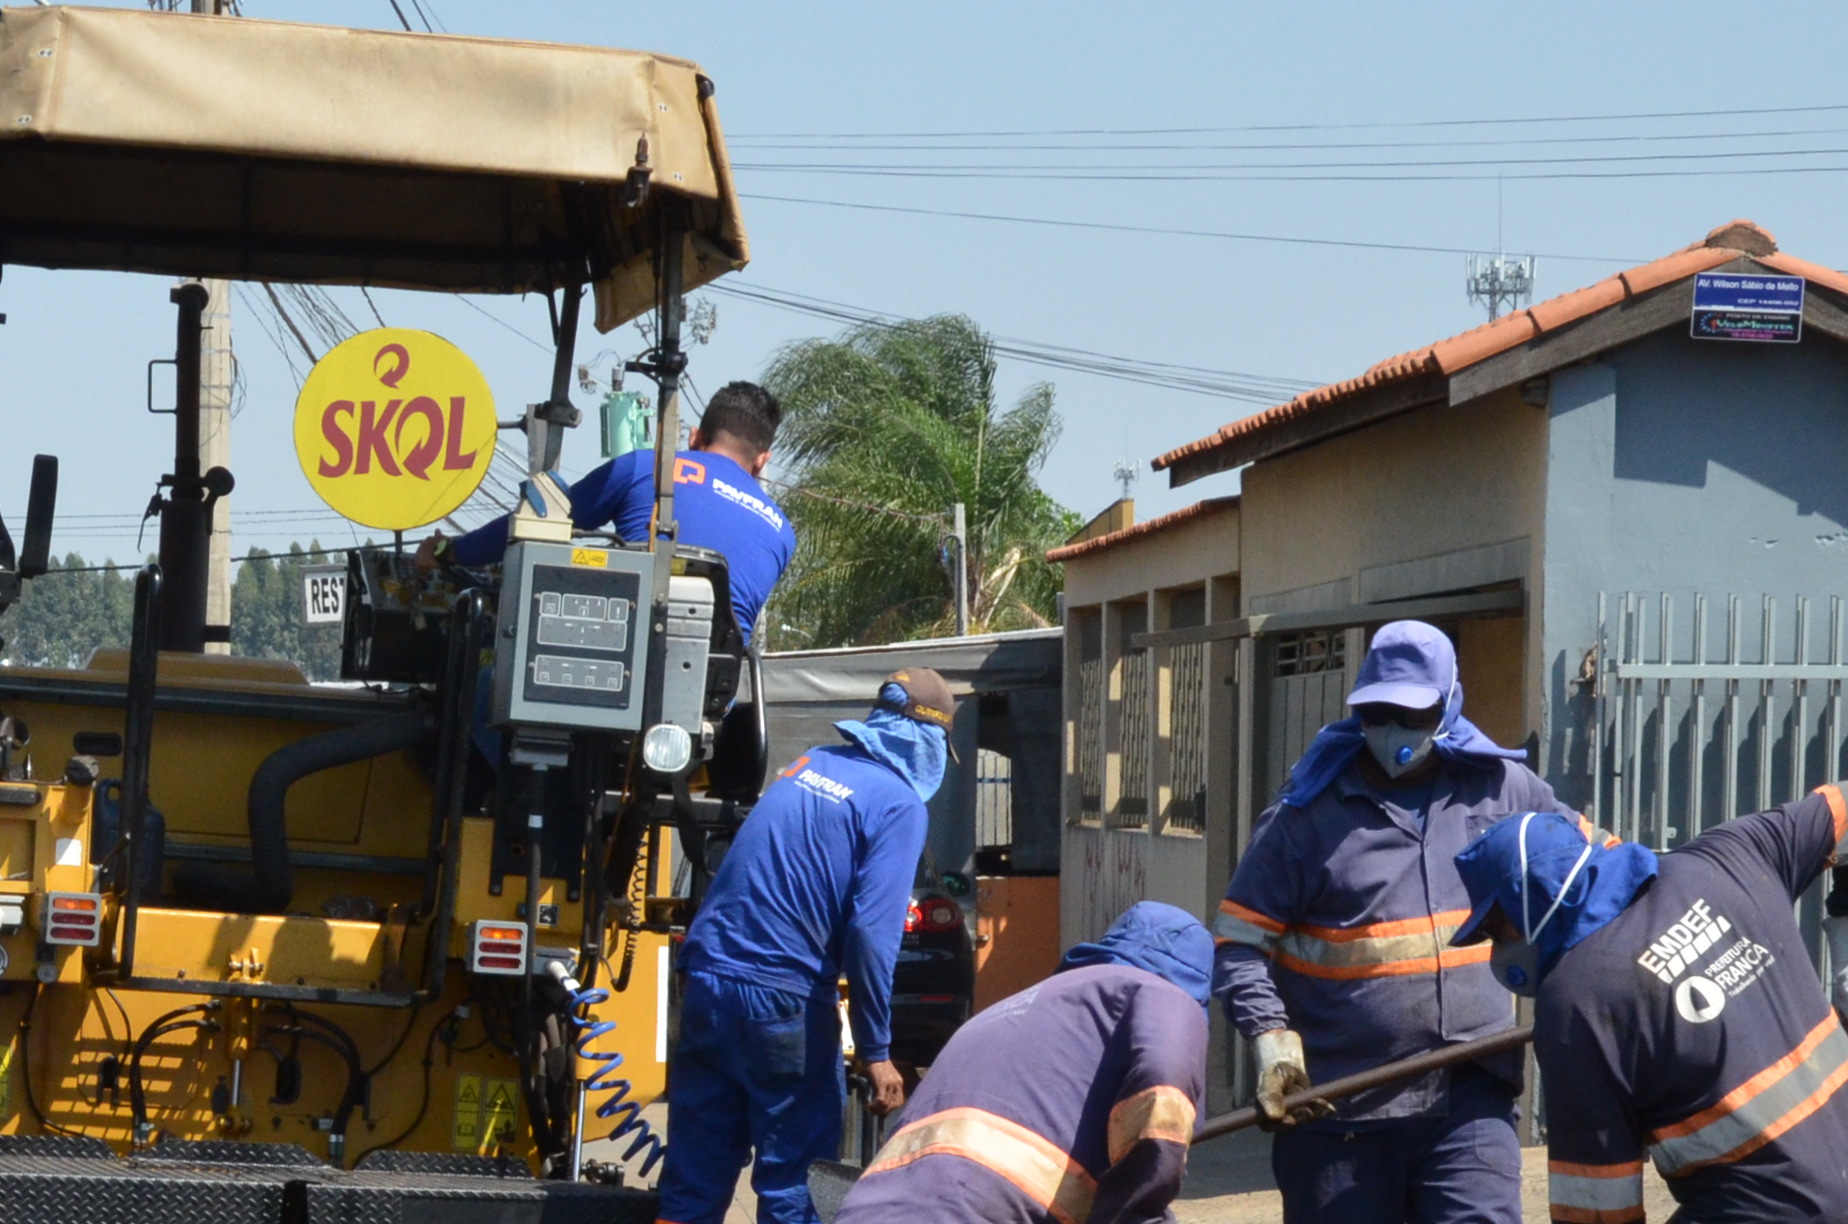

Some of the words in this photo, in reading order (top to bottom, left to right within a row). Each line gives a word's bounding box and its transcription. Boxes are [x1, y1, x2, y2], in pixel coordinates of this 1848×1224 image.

[1698, 279, 1711, 287] AV.
[1713, 279, 1740, 288] Wilson
[1741, 280, 1764, 290] Sábio
[1765, 282, 1776, 290] de
[1777, 282, 1799, 291] Mello
[318, 396, 477, 481] SKOL
[1638, 898, 1711, 974] EMDEF
[1704, 936, 1751, 977] PREFEITURA
[1714, 943, 1769, 990] FRANCA
